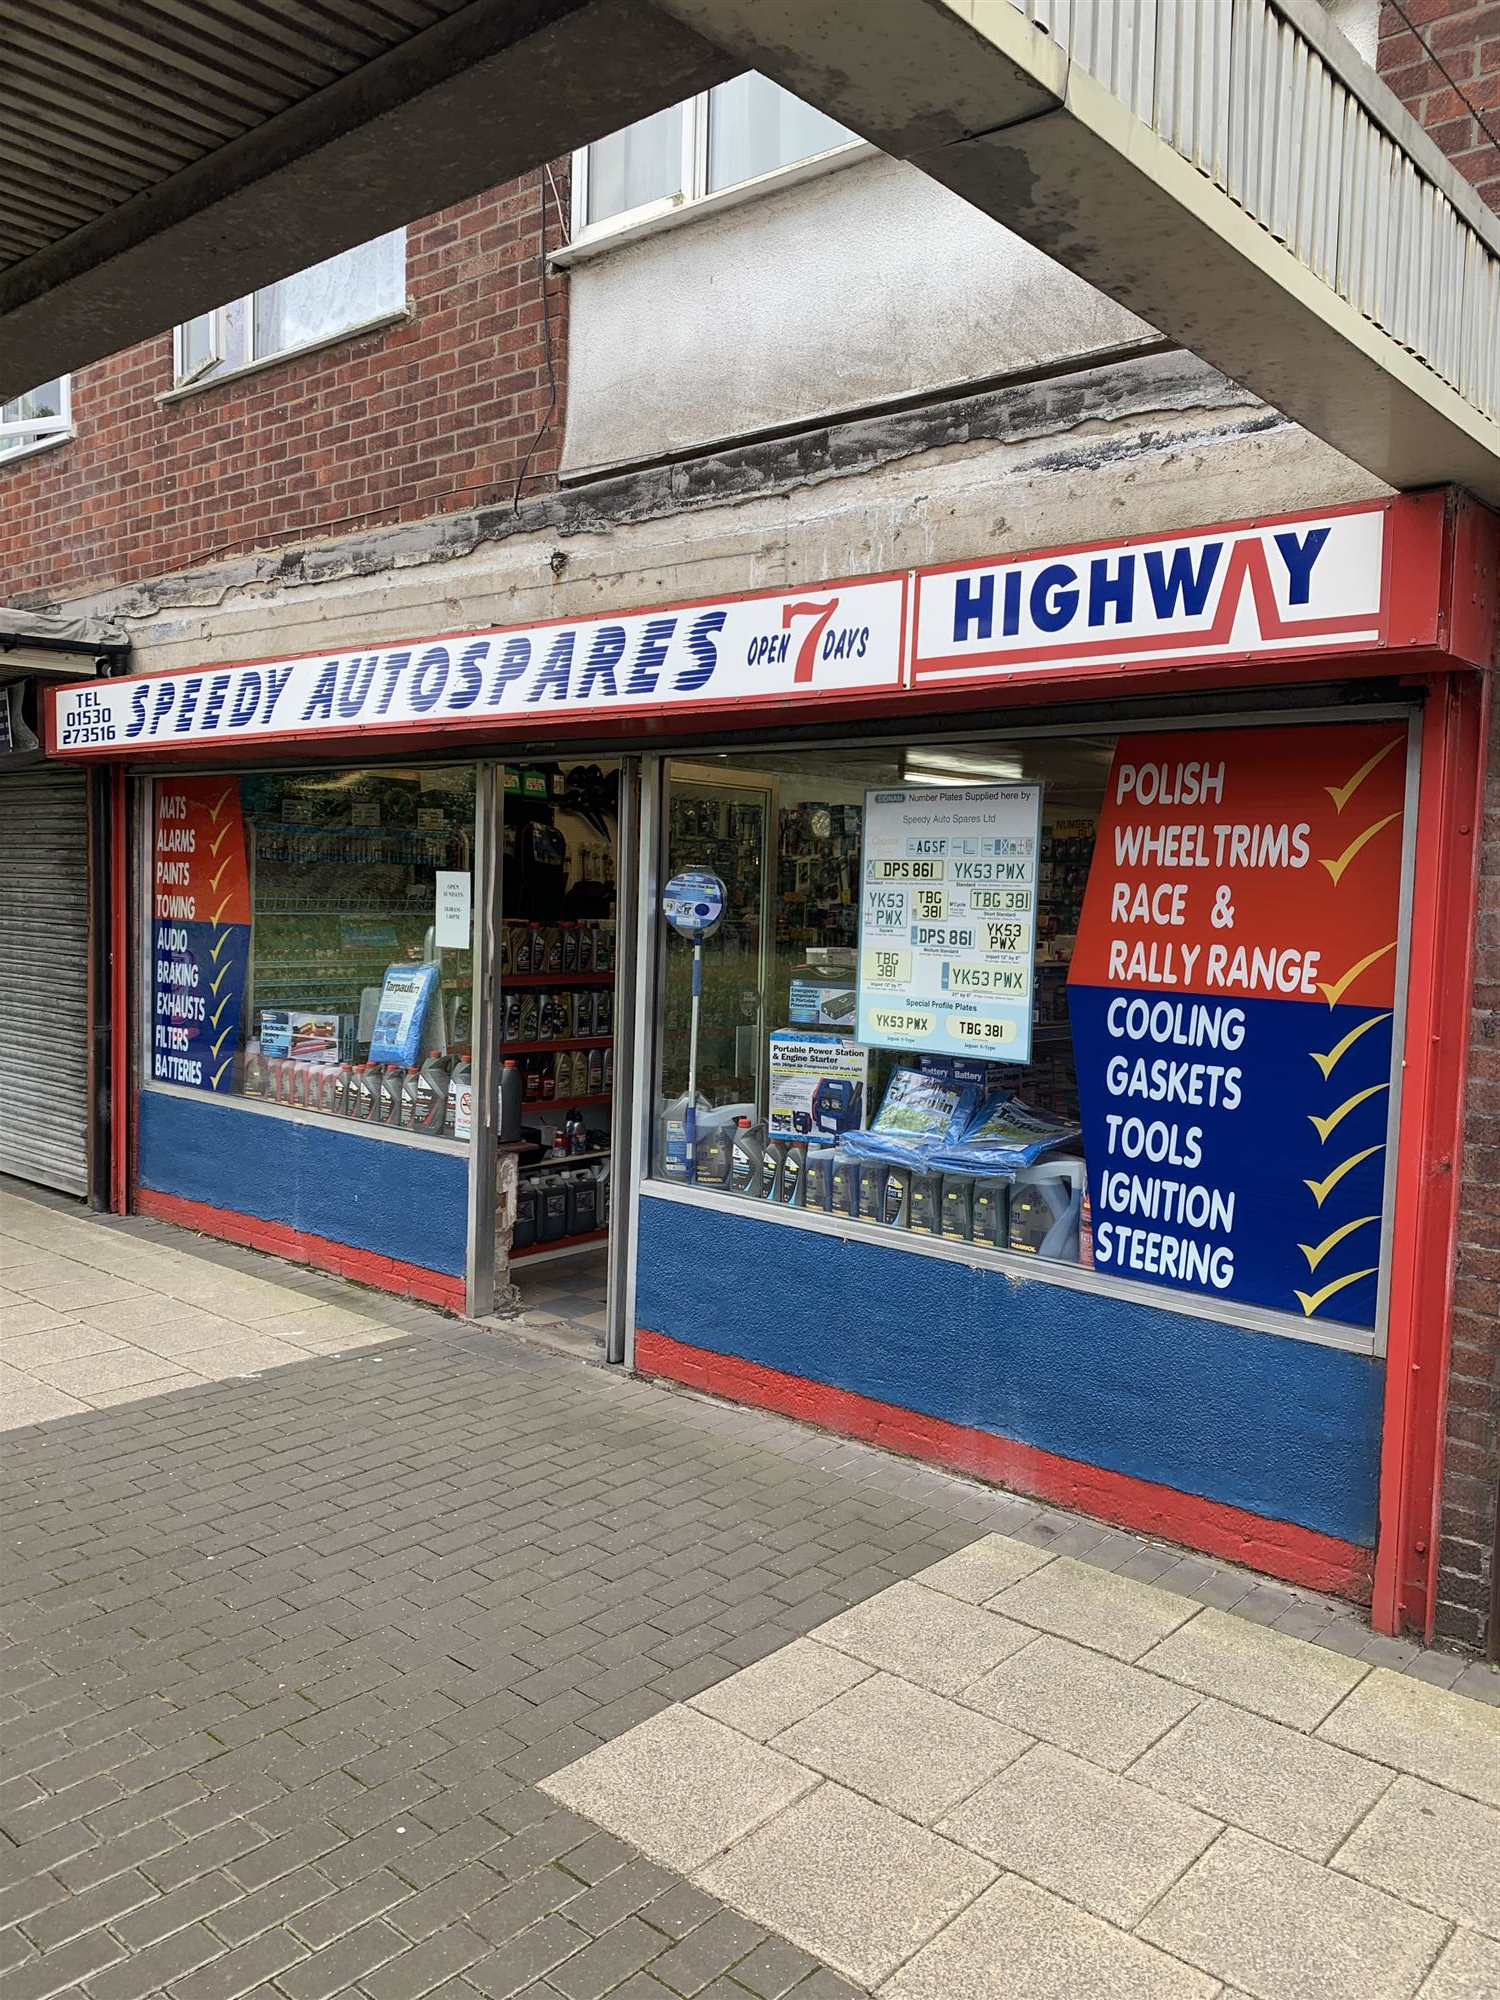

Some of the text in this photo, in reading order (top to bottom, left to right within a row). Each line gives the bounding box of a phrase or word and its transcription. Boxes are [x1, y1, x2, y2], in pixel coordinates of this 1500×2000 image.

[953, 527, 1332, 643] HIGHWAY
[747, 598, 870, 683] OPEN 7 DAYS
[124, 611, 727, 738] SPEEDY AUTOSPARES
[76, 691, 101, 709] TEL
[66, 708, 112, 727] 01530
[62, 725, 116, 745] 273516
[1116, 761, 1225, 806] POLISH
[909, 794, 938, 802] Number
[939, 793, 963, 801] Plates
[965, 792, 999, 803] Supplied
[1000, 791, 1019, 800] here
[1020, 791, 1031, 801] by
[160, 796, 187, 819] MATS
[903, 814, 996, 825] Speedy Auto Spares Ltd
[157, 828, 196, 853] ALARMS
[156, 862, 190, 886] PAINTS
[884, 862, 934, 877] DPS 861
[955, 862, 1025, 879] YK53 PWX
[870, 892, 904, 908] YK53
[918, 891, 942, 904] TBG
[973, 892, 1029, 908] TBG 381
[1111, 883, 1235, 928] RACE &
[156, 895, 195, 920] TOWING
[922, 906, 942, 918] 381
[876, 910, 902, 925] PWX
[919, 929, 972, 946] DPS 861
[987, 922, 1022, 937] YK53
[157, 927, 188, 952] AUDIO
[990, 937, 1017, 950] PWX
[876, 952, 899, 965] TBG
[1108, 940, 1321, 994] RALLY RANGE
[157, 960, 199, 988] BRAKING
[877, 965, 896, 977] 381
[953, 969, 1023, 989] YK53 PWX
[386, 980, 420, 994] Tarpaulin
[156, 992, 205, 1022] EXHAUSTS
[906, 998, 978, 1012] Special Profile Plates
[876, 1014, 928, 1031] YK53 PWX
[959, 1022, 1003, 1038] TBG 381
[1107, 997, 1245, 1051] COOLING
[155, 1024, 189, 1052] FILTERS
[773, 1045, 864, 1057] Portable Power Station
[781, 1053, 808, 1062] Engine
[810, 1055, 838, 1064] Starter
[155, 1053, 202, 1085] BATTERIES
[954, 1071, 982, 1082] Battery
[1106, 1056, 1242, 1110] GASKETS
[1106, 1114, 1203, 1168] TOOLS
[1100, 1170, 1235, 1233] IGNITION
[1095, 1222, 1234, 1289] STEERING
